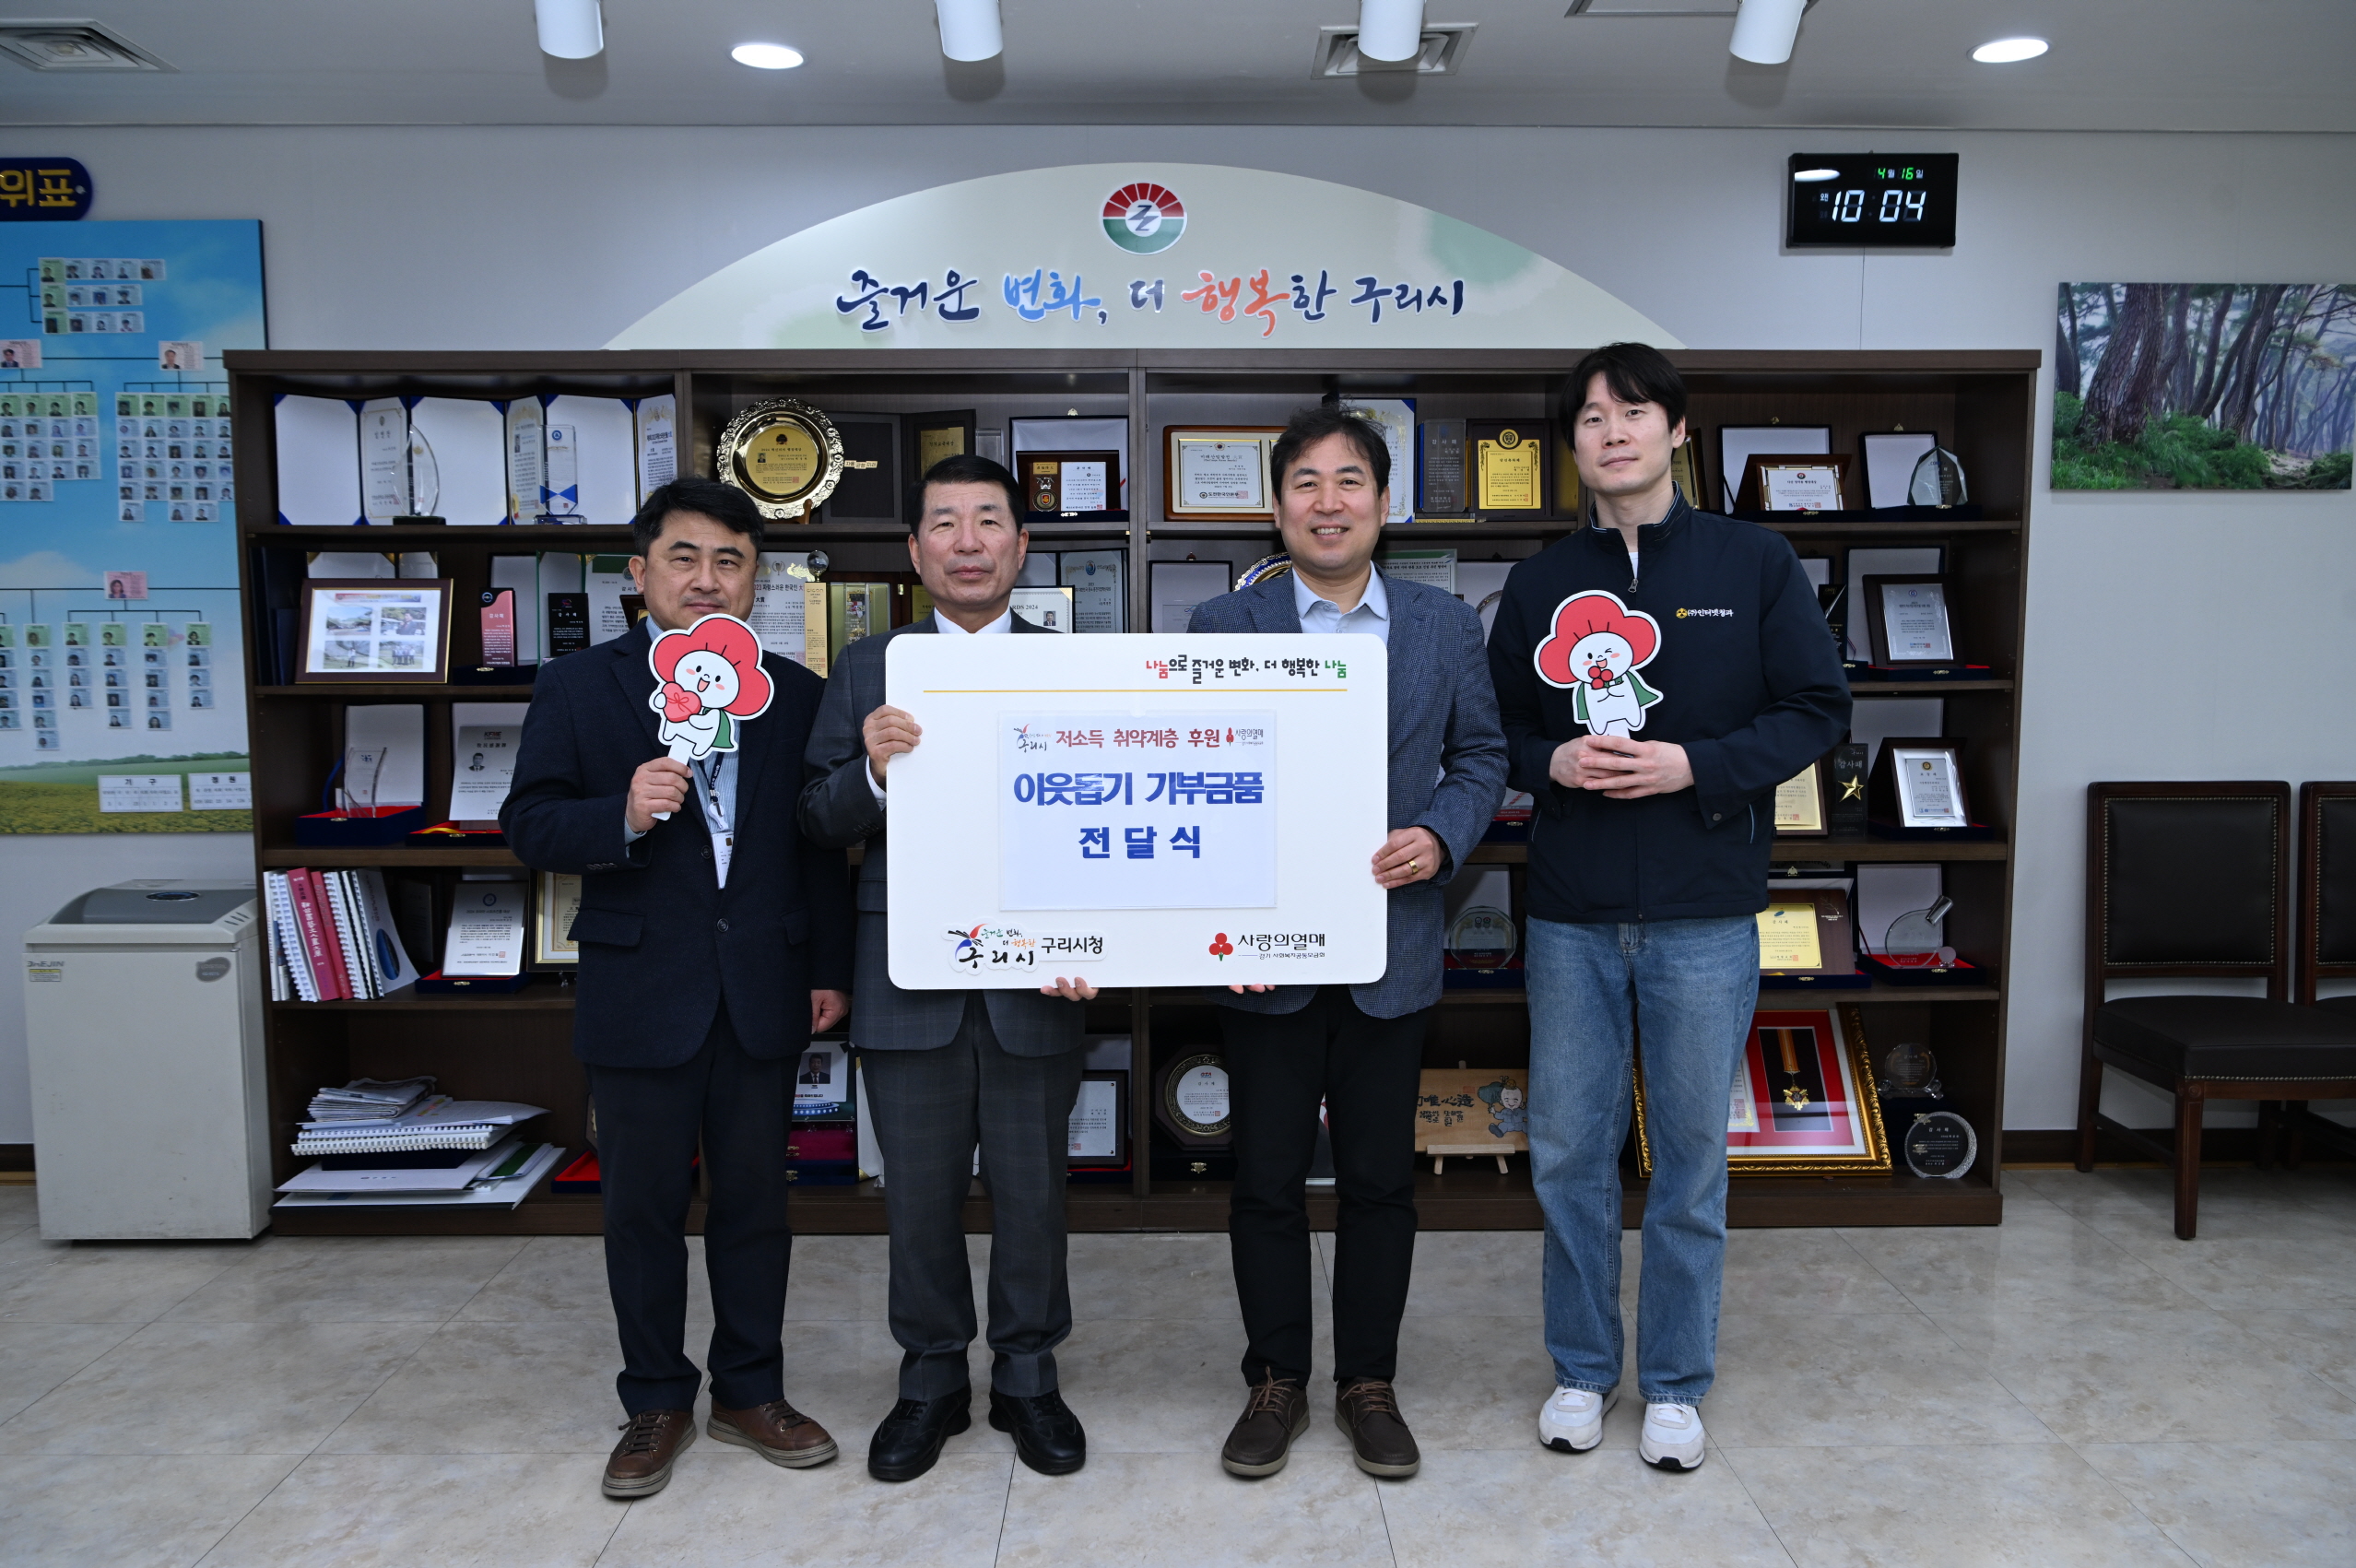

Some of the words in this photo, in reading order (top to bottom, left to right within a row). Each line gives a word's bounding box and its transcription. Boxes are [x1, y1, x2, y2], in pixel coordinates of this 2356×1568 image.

[0, 169, 77, 207] 위표
[837, 269, 979, 330] 즐거운
[1003, 268, 1108, 325] 변화,
[1128, 280, 1165, 313] 더
[1181, 268, 1337, 337] 행복한
[1350, 277, 1464, 324] 구리시
[1146, 654, 1187, 678] 나눔으로
[1192, 659, 1224, 684] 즐거운
[1229, 657, 1260, 678] 변화,
[1265, 660, 1277, 669] 더
[1281, 657, 1320, 678] 행복한
[1325, 660, 1347, 678] 나눔
[1018, 737, 1047, 753] 구리시
[1055, 729, 1104, 748] 저소득
[1113, 728, 1179, 749] 취약계층
[1187, 728, 1220, 749] 후원
[1234, 728, 1264, 741] 사랑의열매
[1013, 772, 1133, 806] 이웃돕기
[1144, 772, 1265, 806] 기부금품
[1078, 826, 1201, 859] 전달식
[981, 928, 1004, 938] 즐거운
[1010, 938, 1036, 949] 행복한
[1238, 933, 1325, 951] 사랑의열매
[1041, 936, 1103, 954] 구리시청
[959, 947, 1034, 969] 구리시
